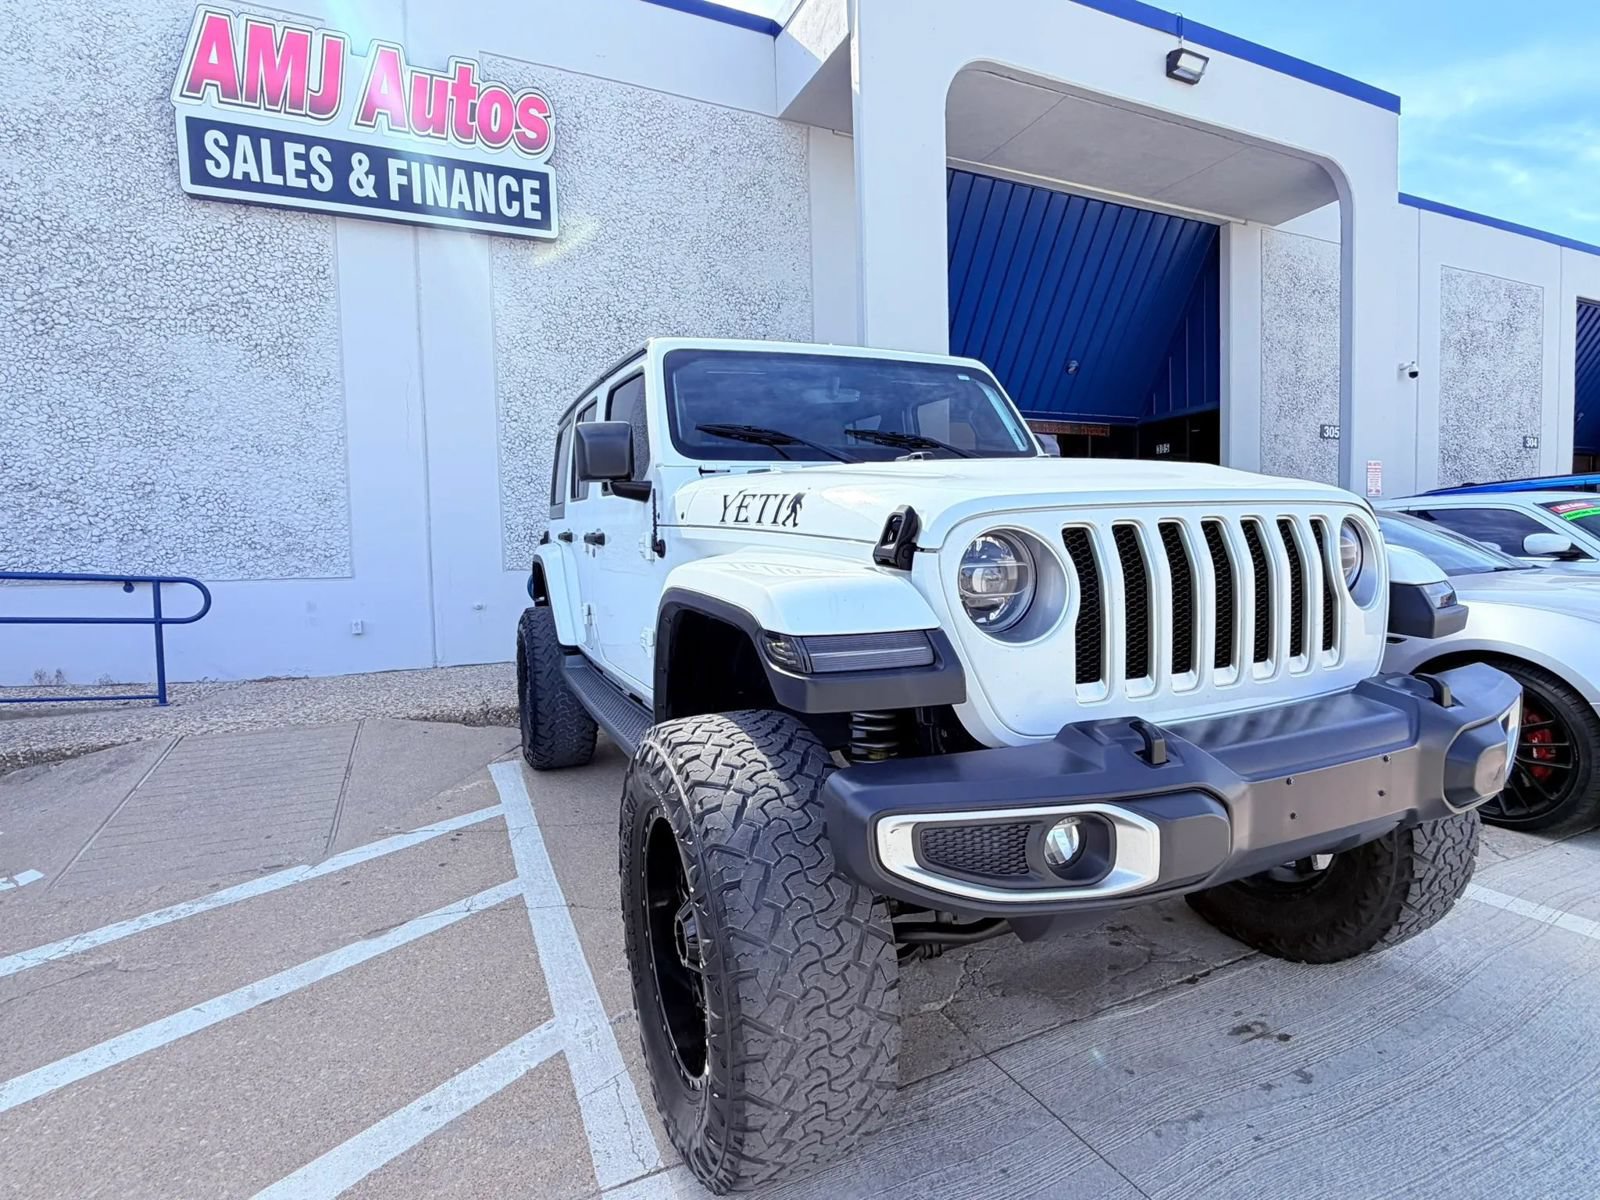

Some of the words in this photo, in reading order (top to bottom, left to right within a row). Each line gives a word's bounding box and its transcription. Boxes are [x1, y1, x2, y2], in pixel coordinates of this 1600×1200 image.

[180, 10, 347, 120] AMJ
[355, 45, 552, 155] Autos
[204, 130, 333, 192] SALES
[348, 152, 378, 199] &
[388, 156, 542, 220] FINANCE
[1323, 426, 1340, 438] 305
[719, 488, 790, 525] YETI
